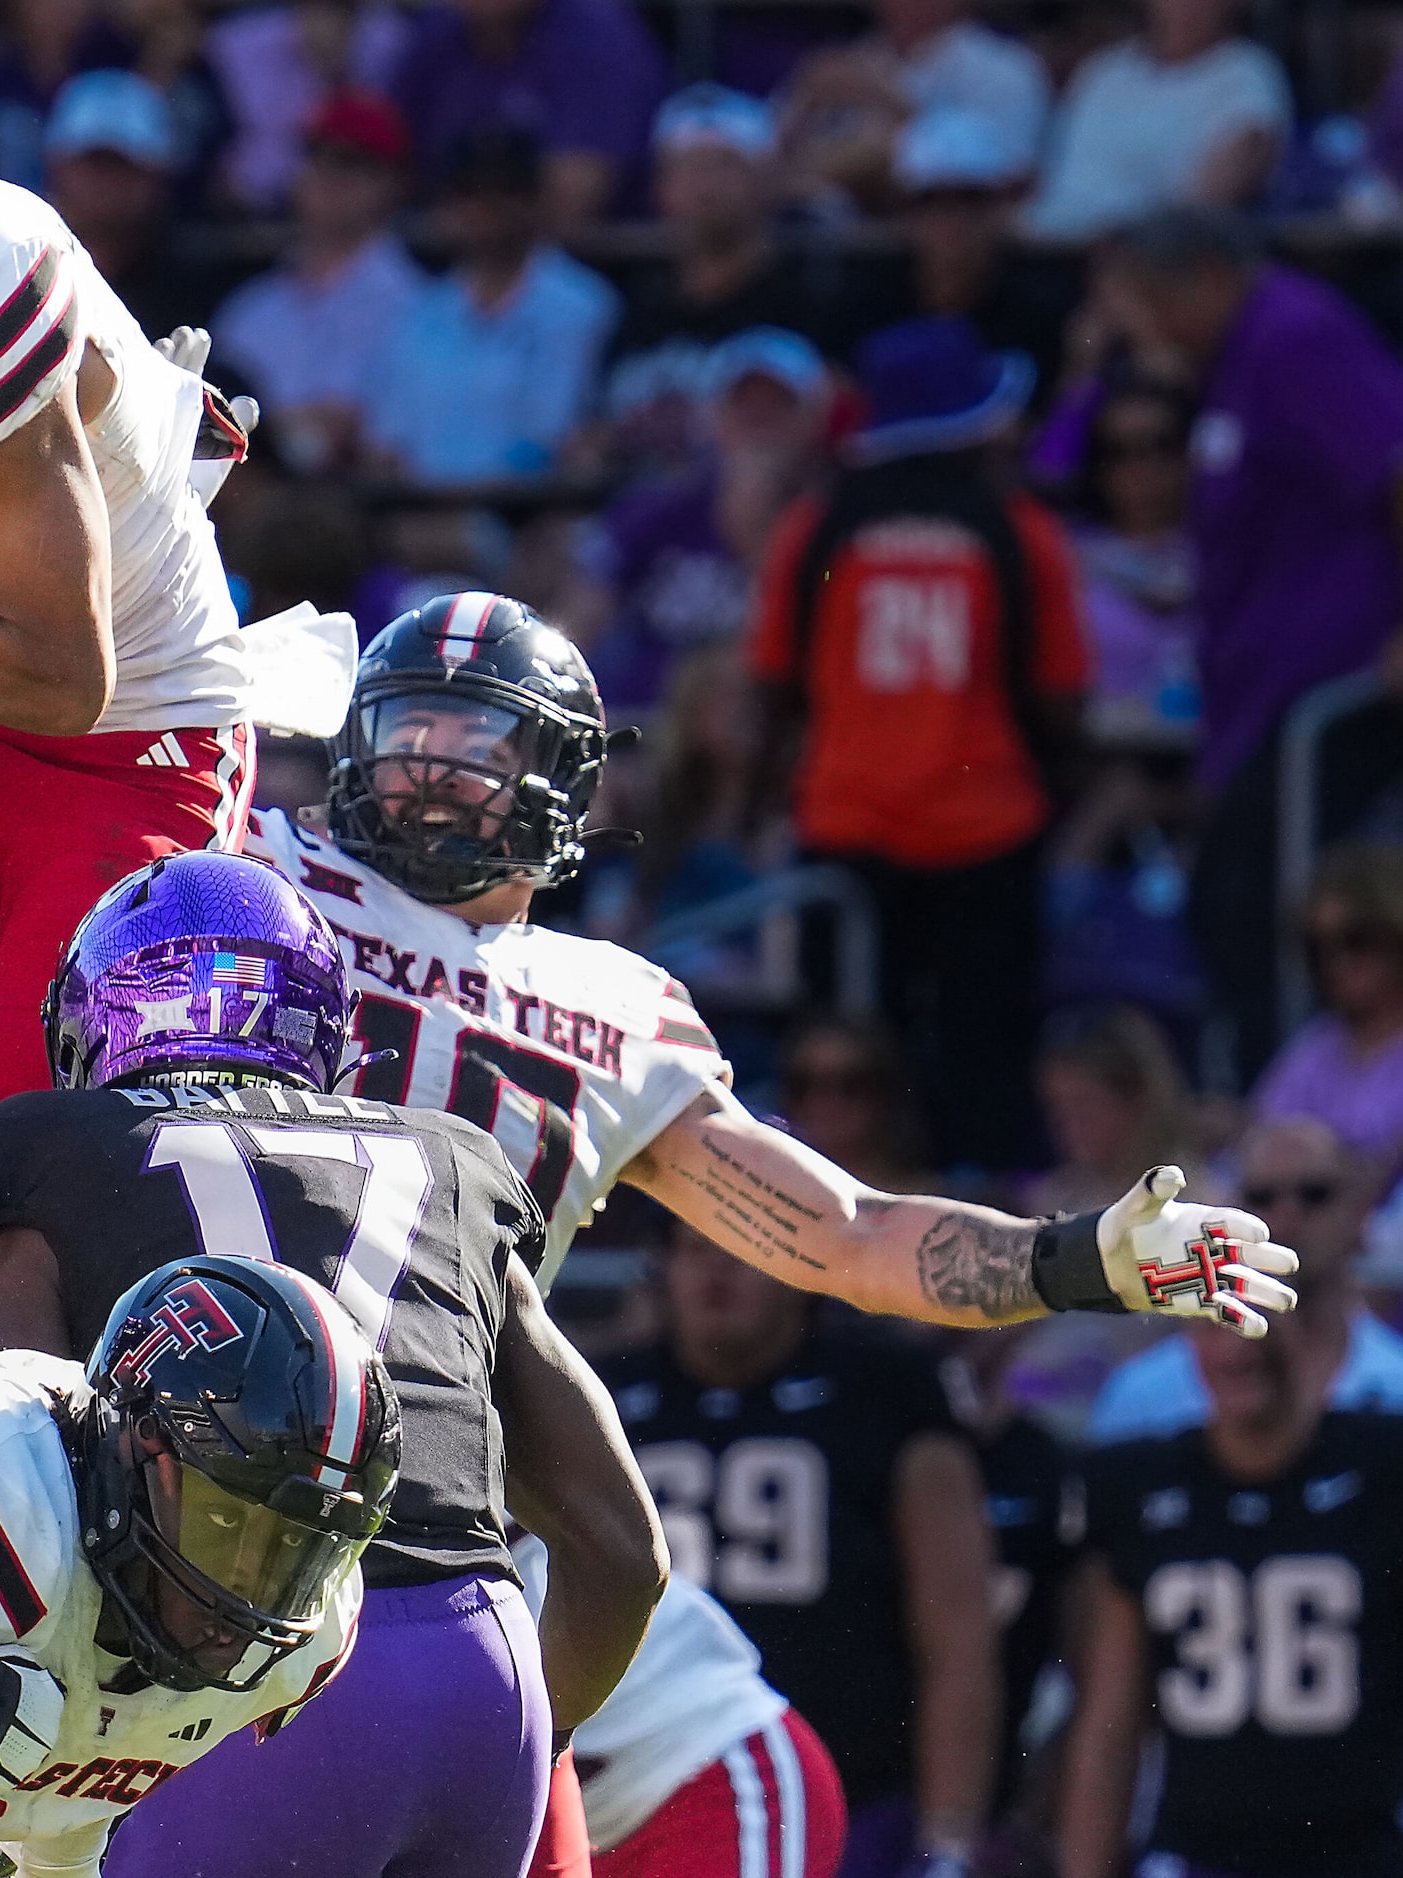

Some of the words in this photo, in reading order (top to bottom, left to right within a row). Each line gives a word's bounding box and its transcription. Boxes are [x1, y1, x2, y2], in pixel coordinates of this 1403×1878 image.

[207, 986, 270, 1037] 17
[506, 984, 626, 1080] TECH
[143, 1124, 435, 1352] 17
[1142, 1552, 1365, 1738] 36
